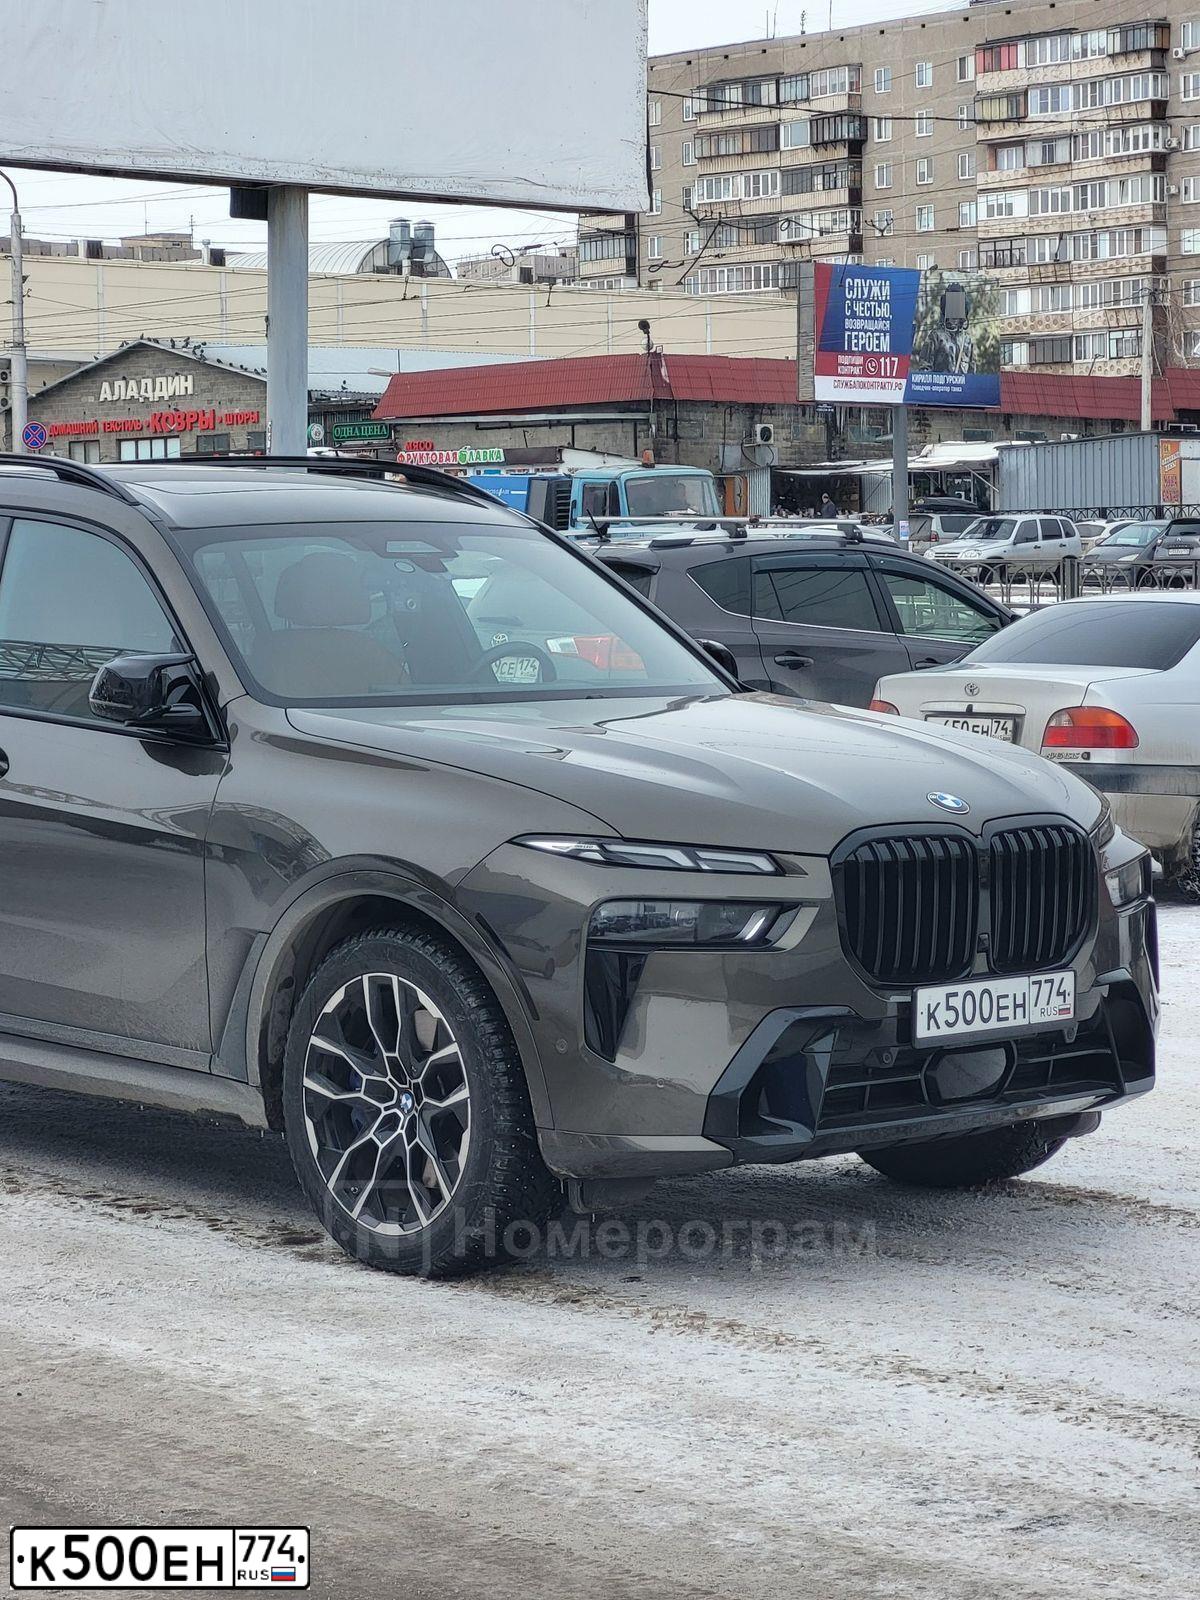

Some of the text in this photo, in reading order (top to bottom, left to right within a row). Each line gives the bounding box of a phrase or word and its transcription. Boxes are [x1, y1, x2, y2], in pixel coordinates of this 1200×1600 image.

[845, 278, 890, 300] СЛУЖИ
[845, 301, 892, 319] С ЧЕСТЬЮ,
[845, 318, 890, 331] ВОЗВРАЩАЙСЯ
[845, 331, 890, 352] ГЕРОЕМ
[838, 366, 862, 375] КОНТРАКТ
[880, 356, 899, 377] 117
[99, 375, 194, 403] АЛАДДИН
[833, 380, 903, 390] СЛУЖБАПОКОНТРАКТУ.РФ
[49, 409, 259, 437] ДОМАШНИЙ ТЕКСТИЛЬ КОВРЫ ШТОРЫ
[334, 427, 360, 438] ОДНА
[361, 425, 387, 437] ЦЕНА
[405, 440, 434, 451] МЯСО
[397, 449, 503, 465] ФРУКТОВАЯ ЛАВКА
[518, 658, 537, 672] 174
[993, 720, 1008, 735] 74
[927, 977, 1066, 1031] К500ЕН 774
[1040, 1008, 1057, 1018] RUS
